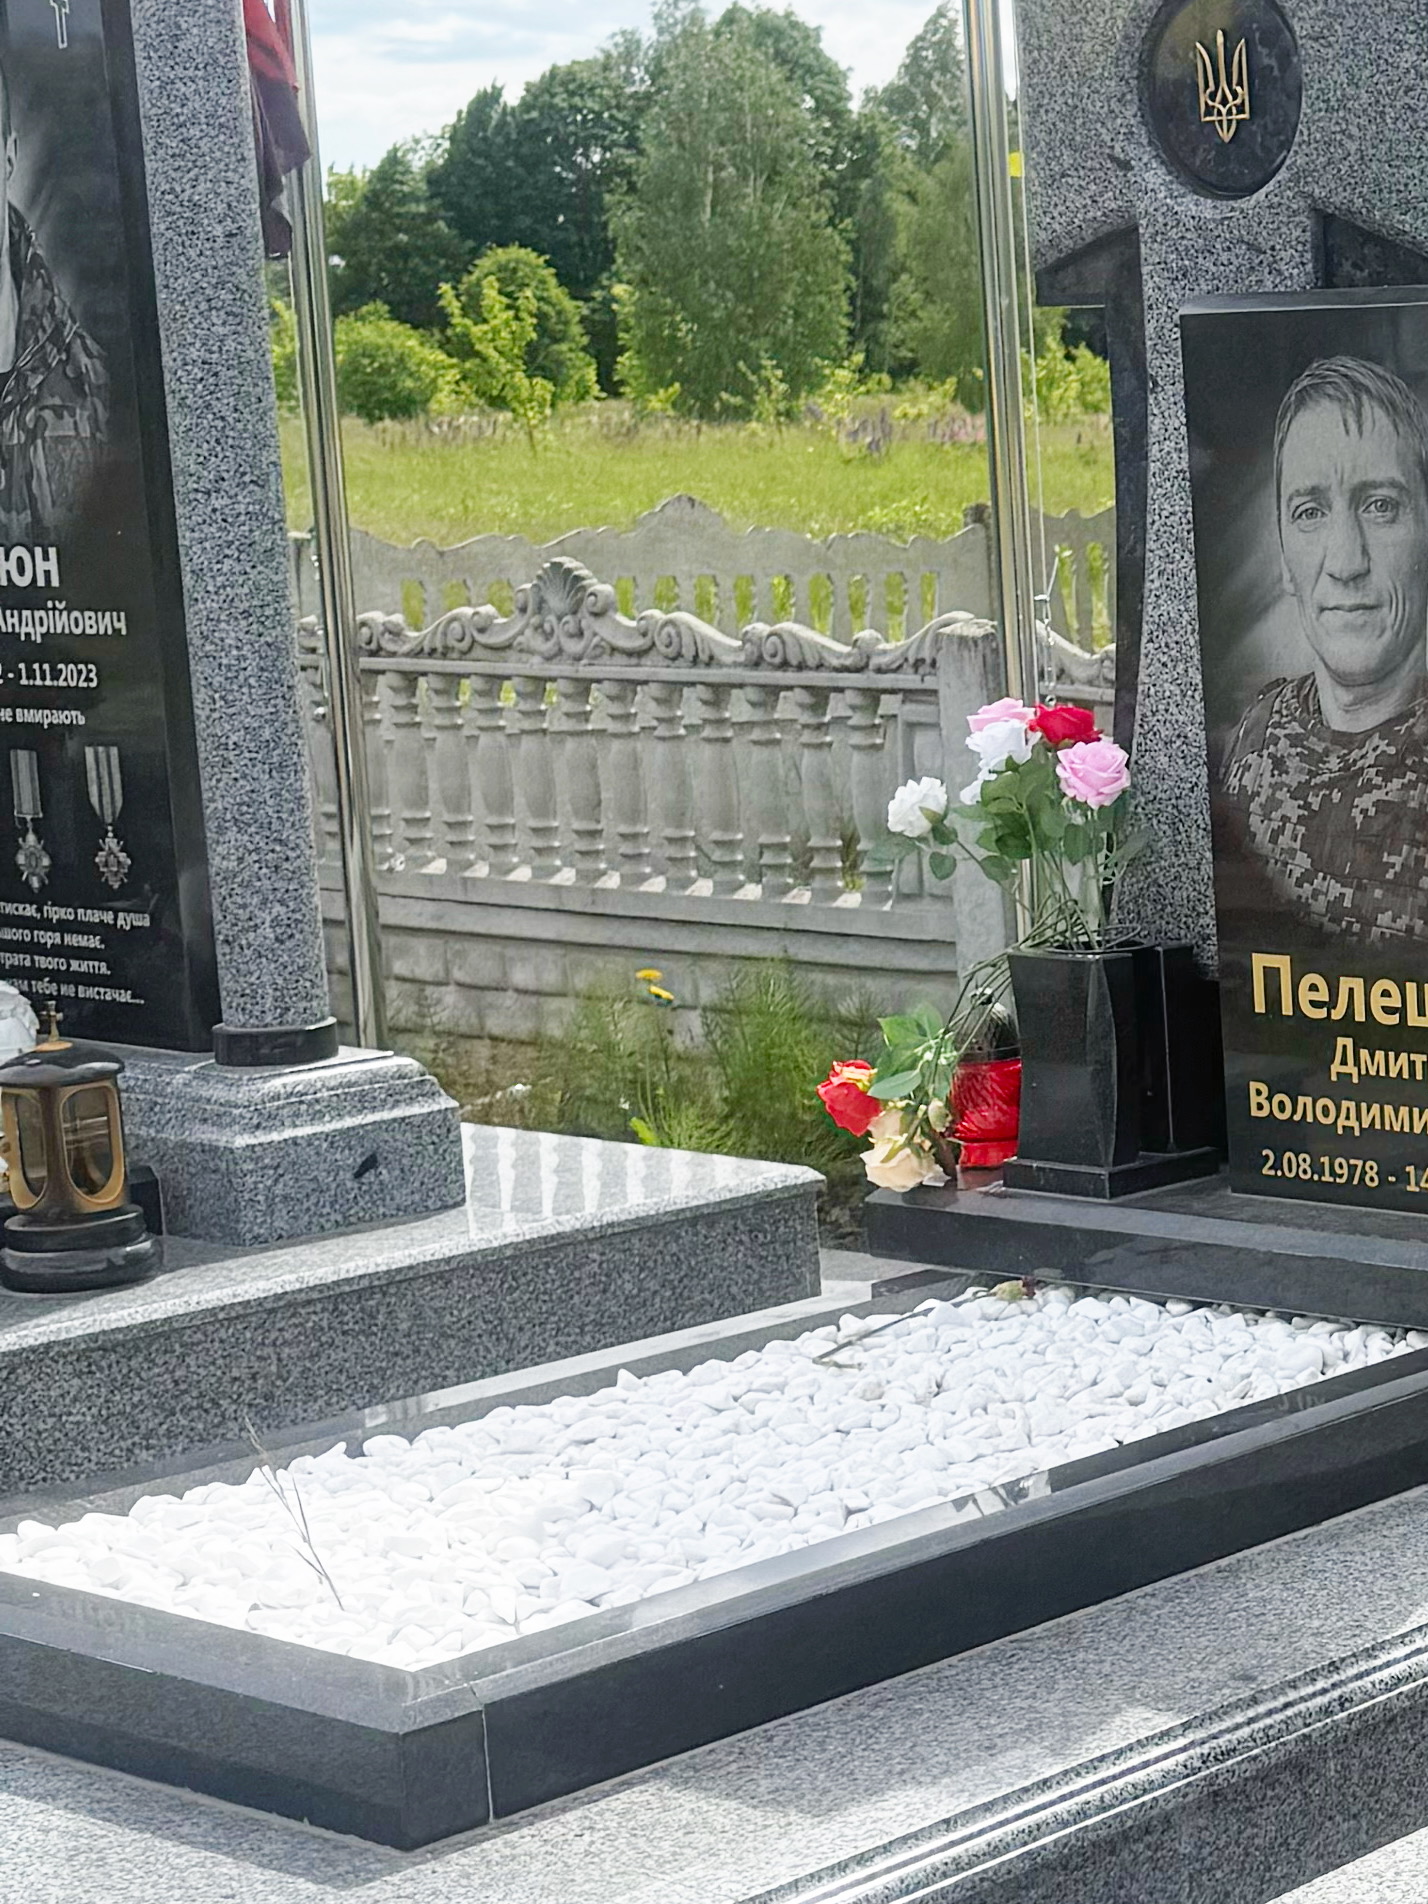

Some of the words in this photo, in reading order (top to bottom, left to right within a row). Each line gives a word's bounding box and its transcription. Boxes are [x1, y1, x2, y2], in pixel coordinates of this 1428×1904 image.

[18, 663, 98, 688] 1.11.2023
[16, 708, 86, 729] вмирають
[77, 908, 114, 924] плаче
[117, 911, 150, 930] душа
[33, 929, 61, 949] горя
[33, 955, 67, 971] твого
[70, 959, 111, 975] життя.
[31, 977, 58, 996] тебе
[60, 983, 75, 997] не
[1262, 1149, 1379, 1188] 2.08.1978
